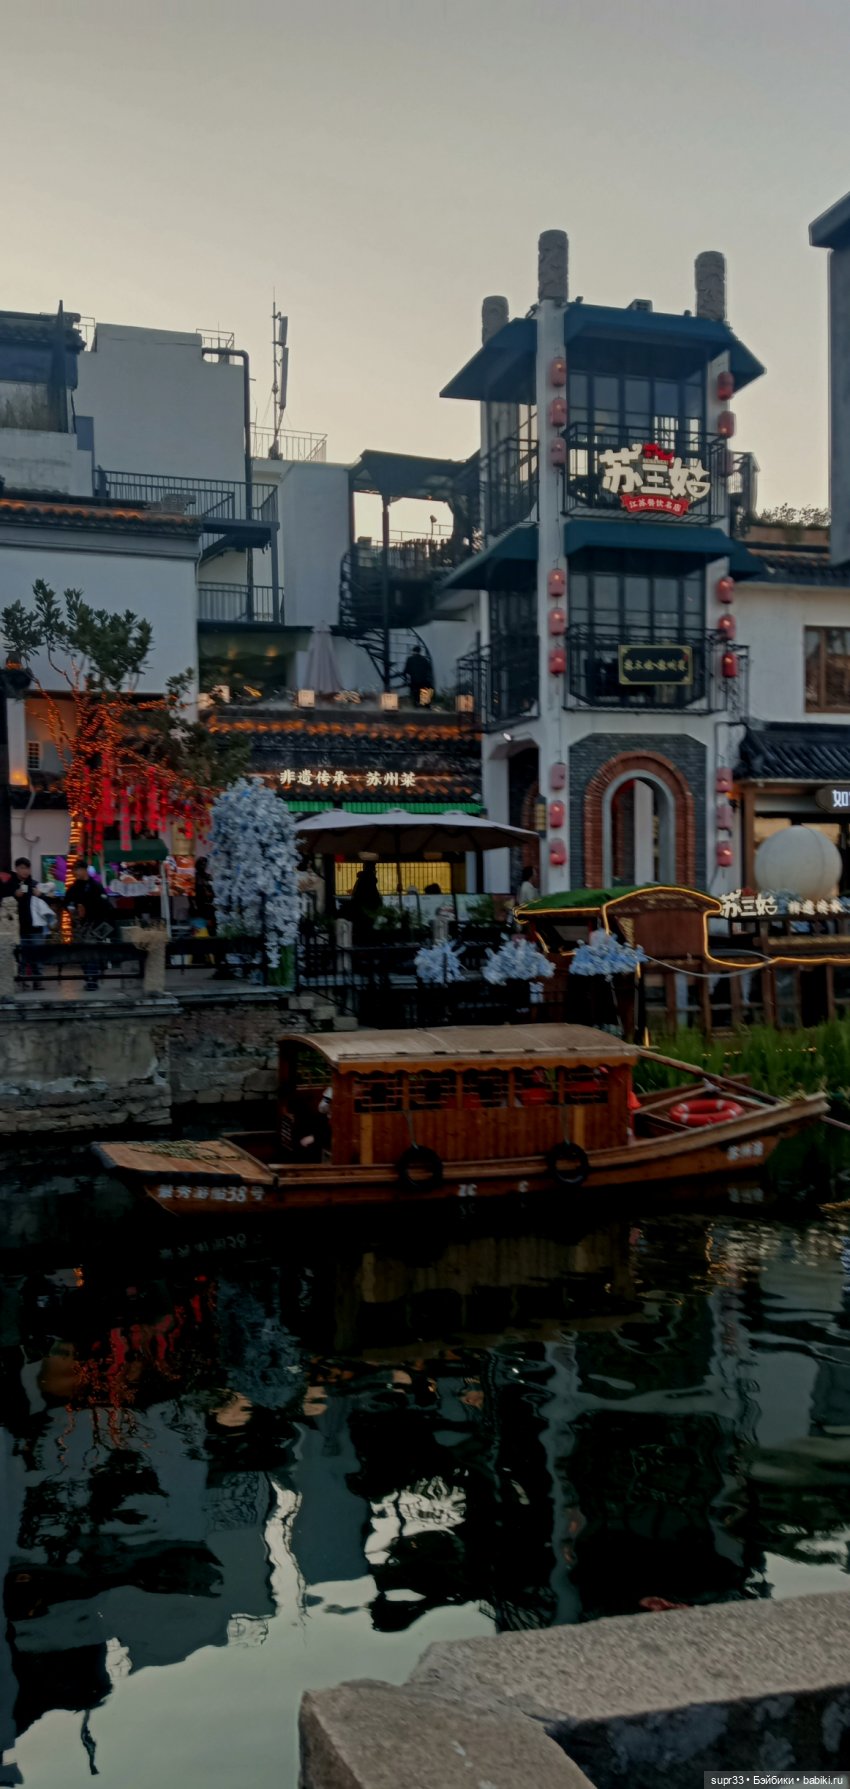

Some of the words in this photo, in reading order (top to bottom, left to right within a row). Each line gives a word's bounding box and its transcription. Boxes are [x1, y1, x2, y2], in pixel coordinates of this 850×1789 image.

[629, 498, 682, 512] 江苏餐饮名店
